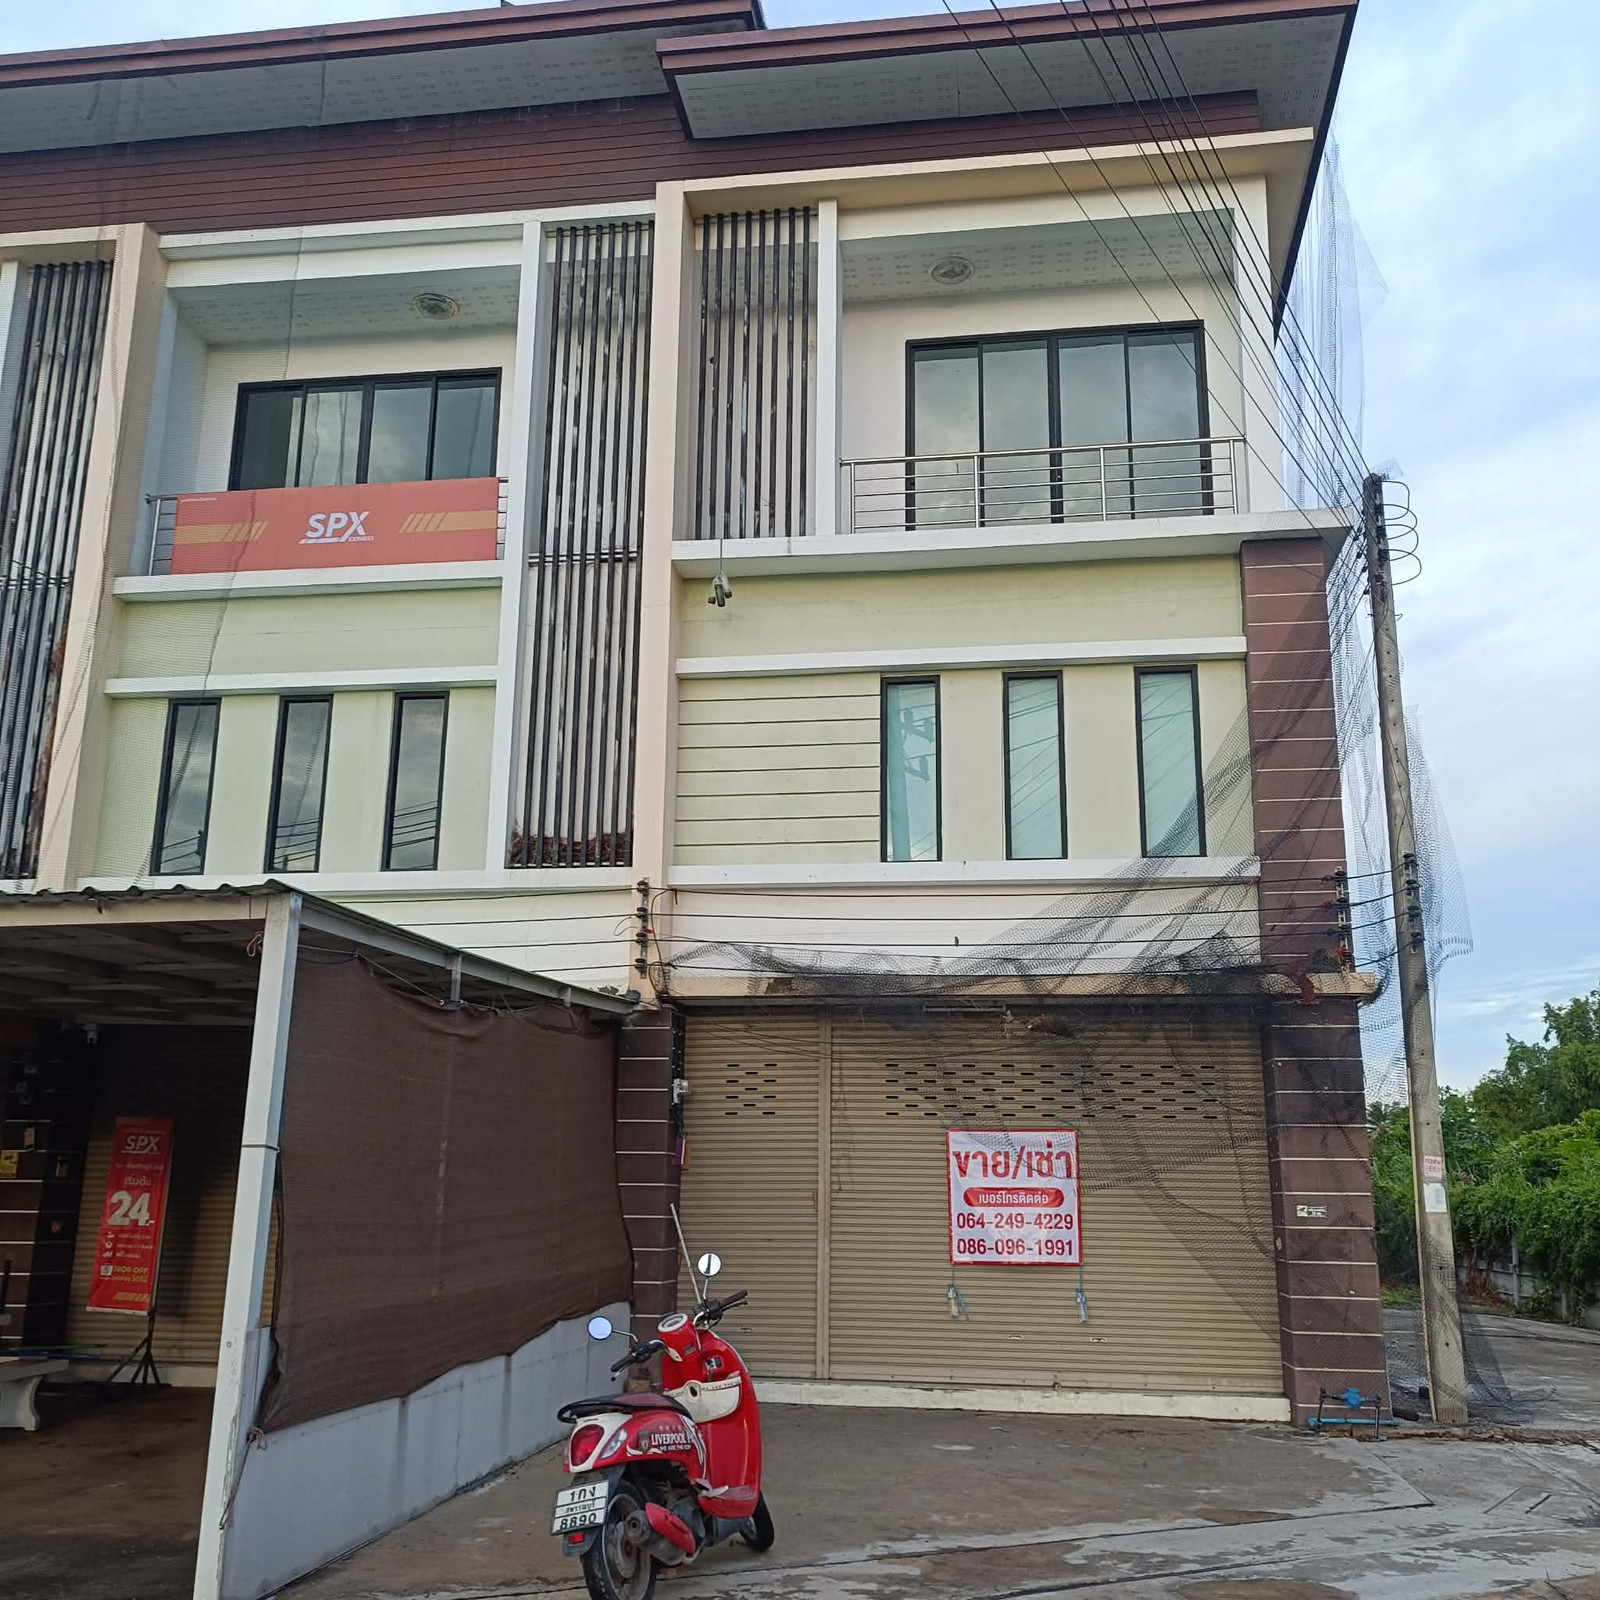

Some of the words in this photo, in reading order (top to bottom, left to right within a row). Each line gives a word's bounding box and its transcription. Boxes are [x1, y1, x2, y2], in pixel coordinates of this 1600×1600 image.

[303, 511, 370, 543] SPX
[122, 1135, 160, 1154] SPX
[952, 1140, 1072, 1180] ขาย/เช่า
[979, 1190, 1049, 1205] เบอร์โทรติดต่อ
[956, 1212, 1074, 1230] 064-249-4229
[956, 1238, 1073, 1256] 086-096-1991
[651, 1432, 687, 1446] LIVERPOOL
[570, 1486, 596, 1502] 1กง
[560, 1512, 597, 1530] 8890
